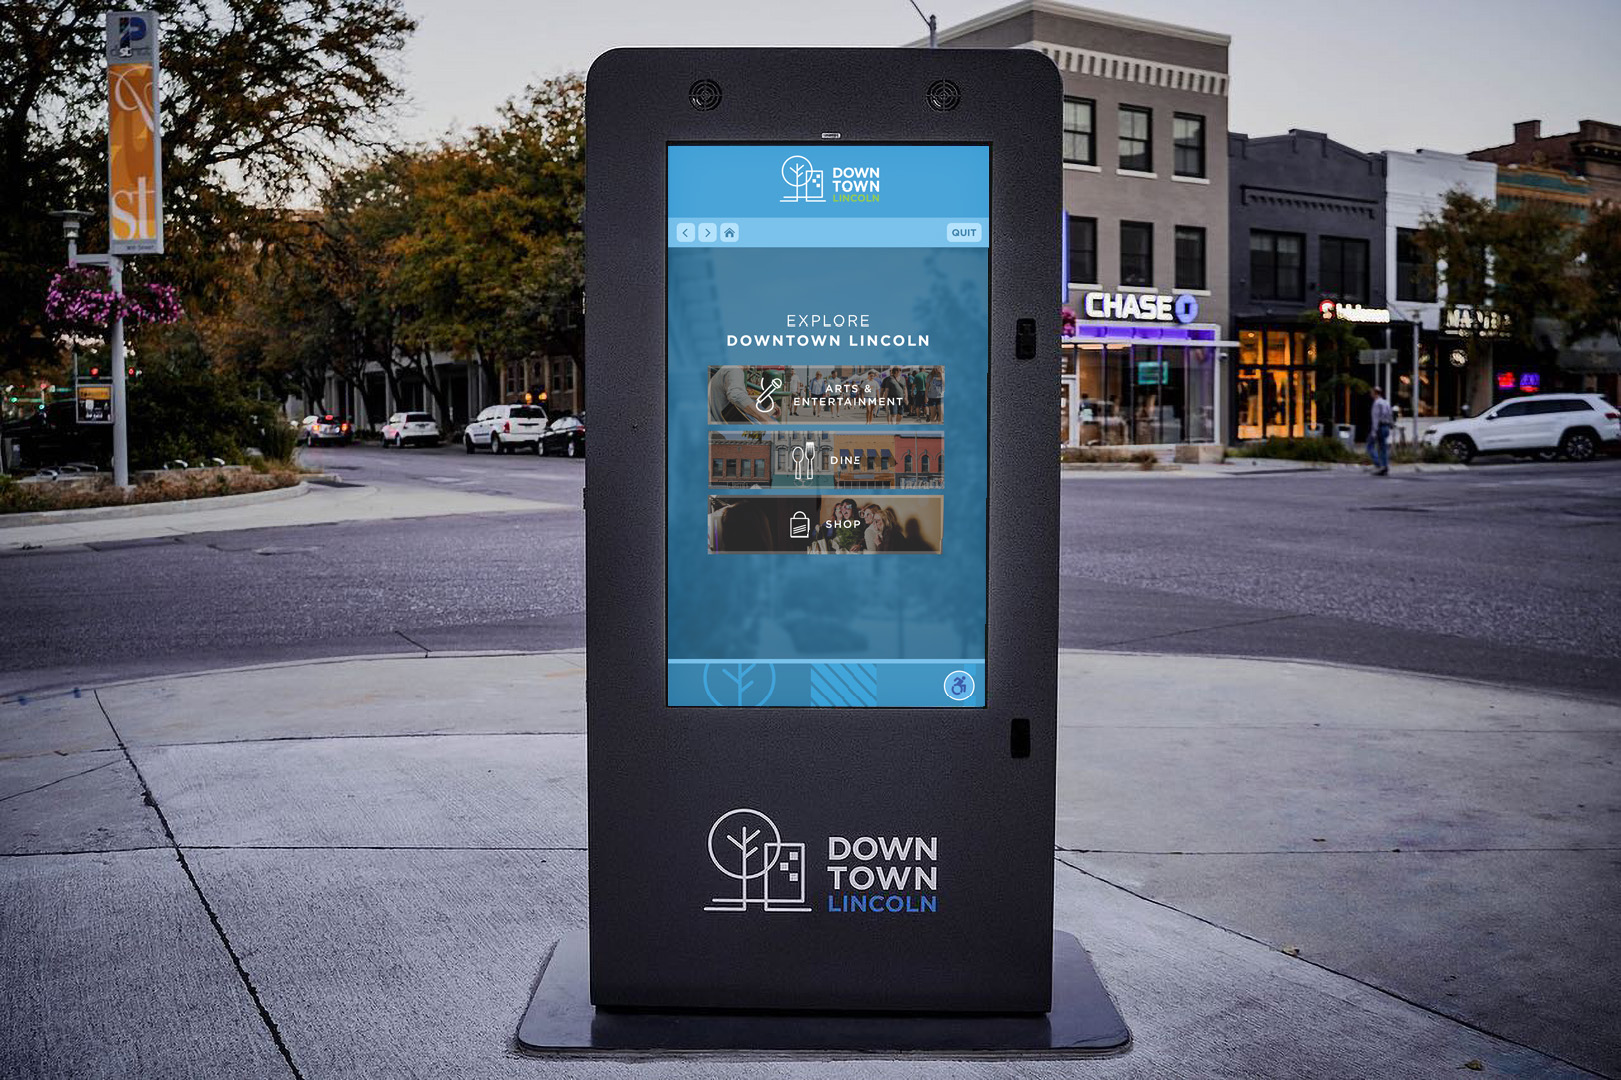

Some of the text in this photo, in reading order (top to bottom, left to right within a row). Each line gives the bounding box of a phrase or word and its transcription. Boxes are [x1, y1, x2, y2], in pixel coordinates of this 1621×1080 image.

[832, 167, 880, 179] DOWN
[832, 180, 880, 193] TOWN
[832, 194, 880, 203] LINCOLN
[951, 228, 977, 238] QUIT
[1085, 292, 1174, 321] CHASE
[787, 314, 870, 328] EXPLORE
[727, 334, 930, 347] DOWNTOWN LINCOLN
[825, 384, 872, 393] ARTS &
[793, 397, 903, 406] ENTERTAINMENT
[830, 456, 861, 465] DINE
[825, 519, 861, 529] SHOP
[828, 837, 937, 861] DOWN
[827, 866, 937, 890] TOWN
[828, 895, 937, 912] LINCOLN
